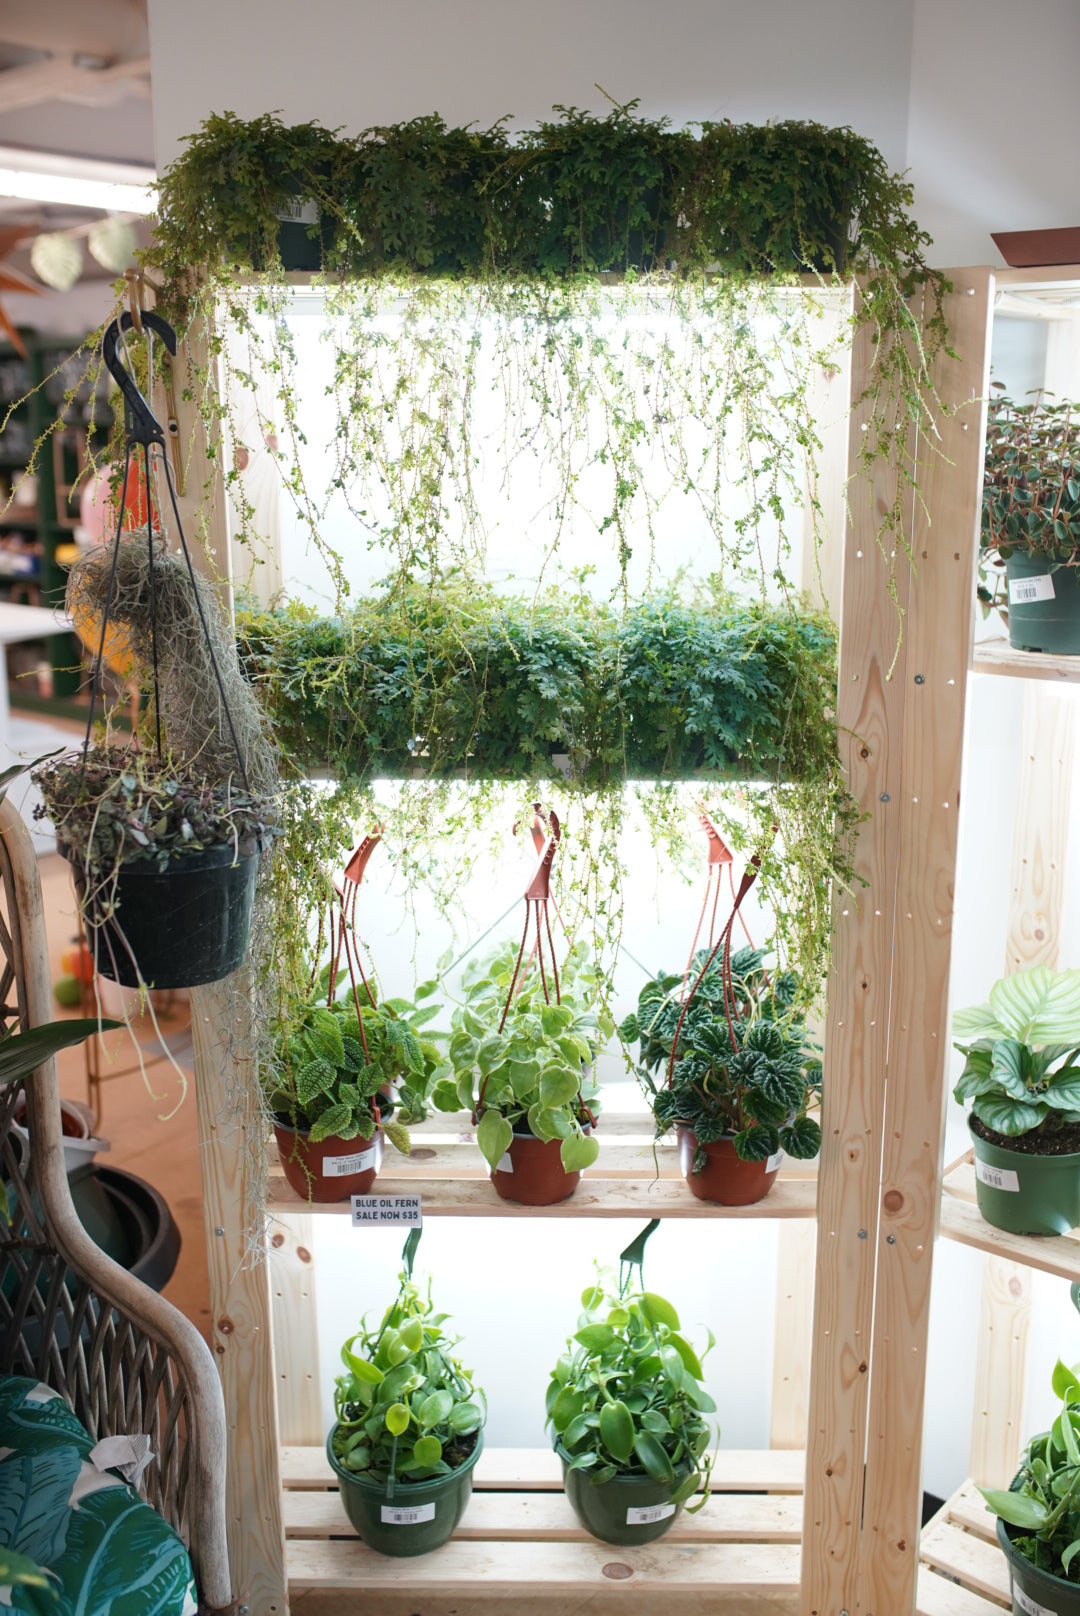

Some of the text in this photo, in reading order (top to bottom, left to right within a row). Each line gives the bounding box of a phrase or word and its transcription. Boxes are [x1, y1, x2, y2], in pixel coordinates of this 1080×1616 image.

[355, 1199, 418, 1208] BLUE OIL FERN
[356, 1211, 418, 1220] SALE NOW $35
